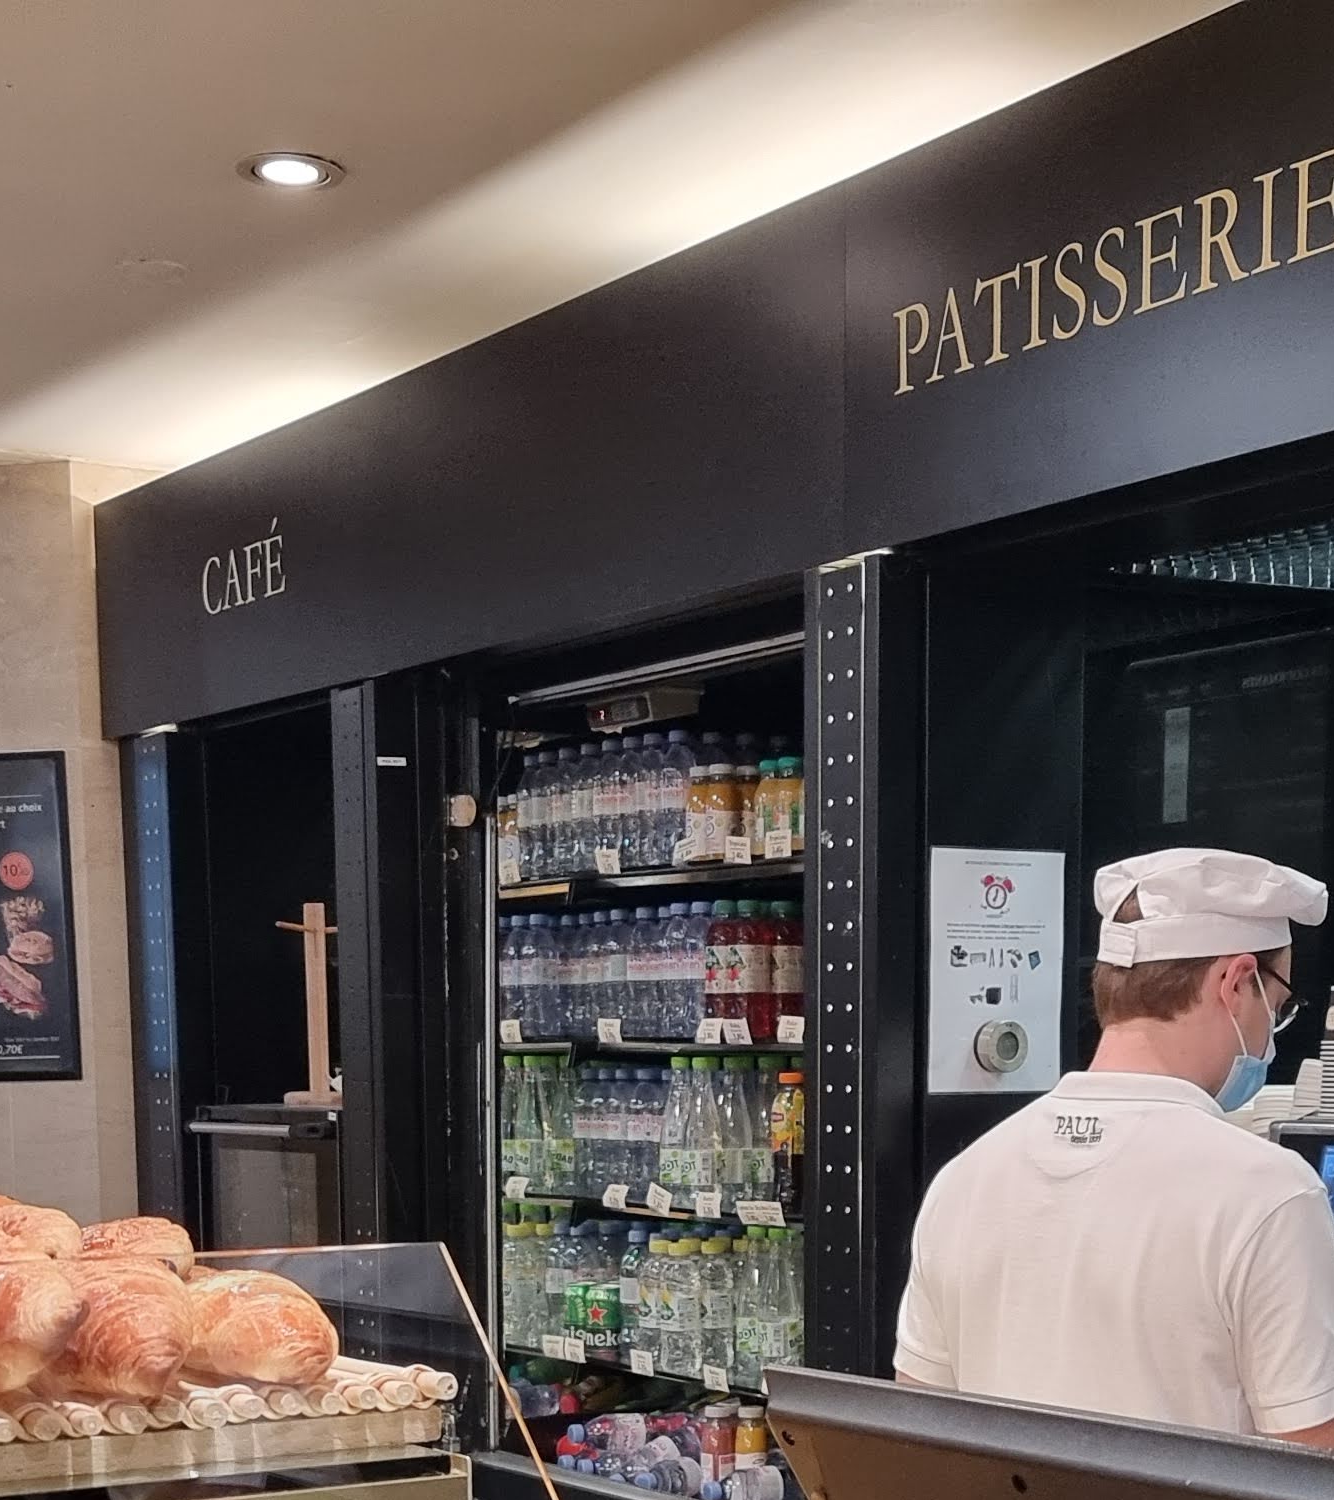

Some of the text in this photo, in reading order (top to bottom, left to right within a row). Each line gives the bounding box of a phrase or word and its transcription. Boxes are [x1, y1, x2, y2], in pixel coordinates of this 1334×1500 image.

[202, 516, 286, 615] CAFÉ
[5, 805, 16, 813] au
[18, 803, 43, 813] choix
[1054, 1116, 1104, 1135] PAUL
